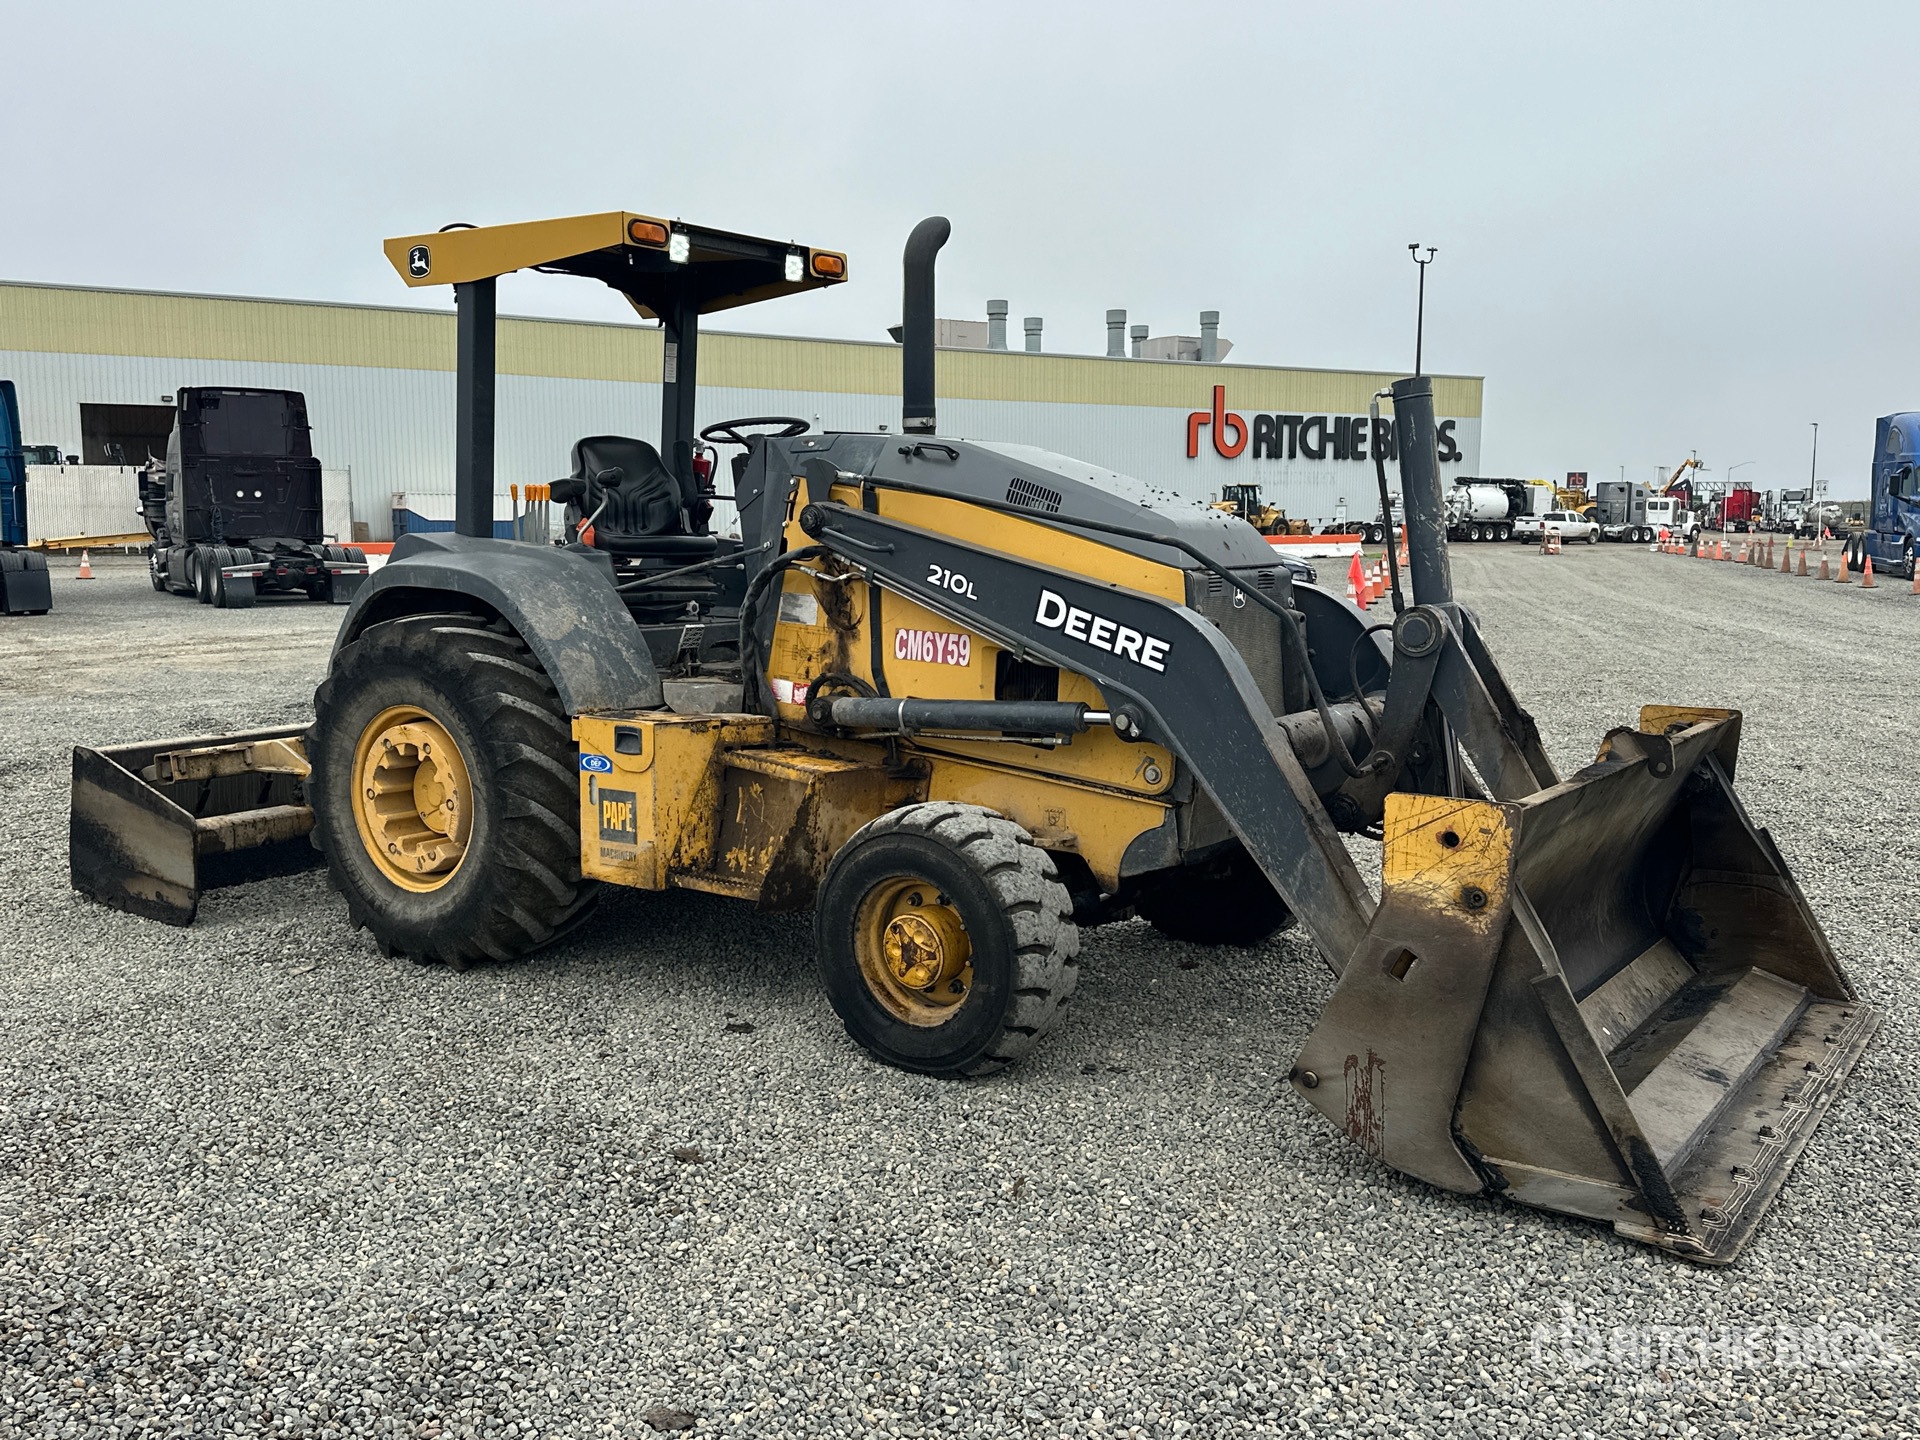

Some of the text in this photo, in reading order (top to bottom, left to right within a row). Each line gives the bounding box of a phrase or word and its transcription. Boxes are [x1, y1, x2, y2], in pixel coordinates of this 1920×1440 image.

[1187, 385, 1462, 462] rb RITCHIE BS.
[926, 563, 978, 601] 210L
[894, 628, 971, 667] CM6Y59
[1034, 589, 1171, 673] DEERE
[600, 847, 637, 862] MACHINERY
